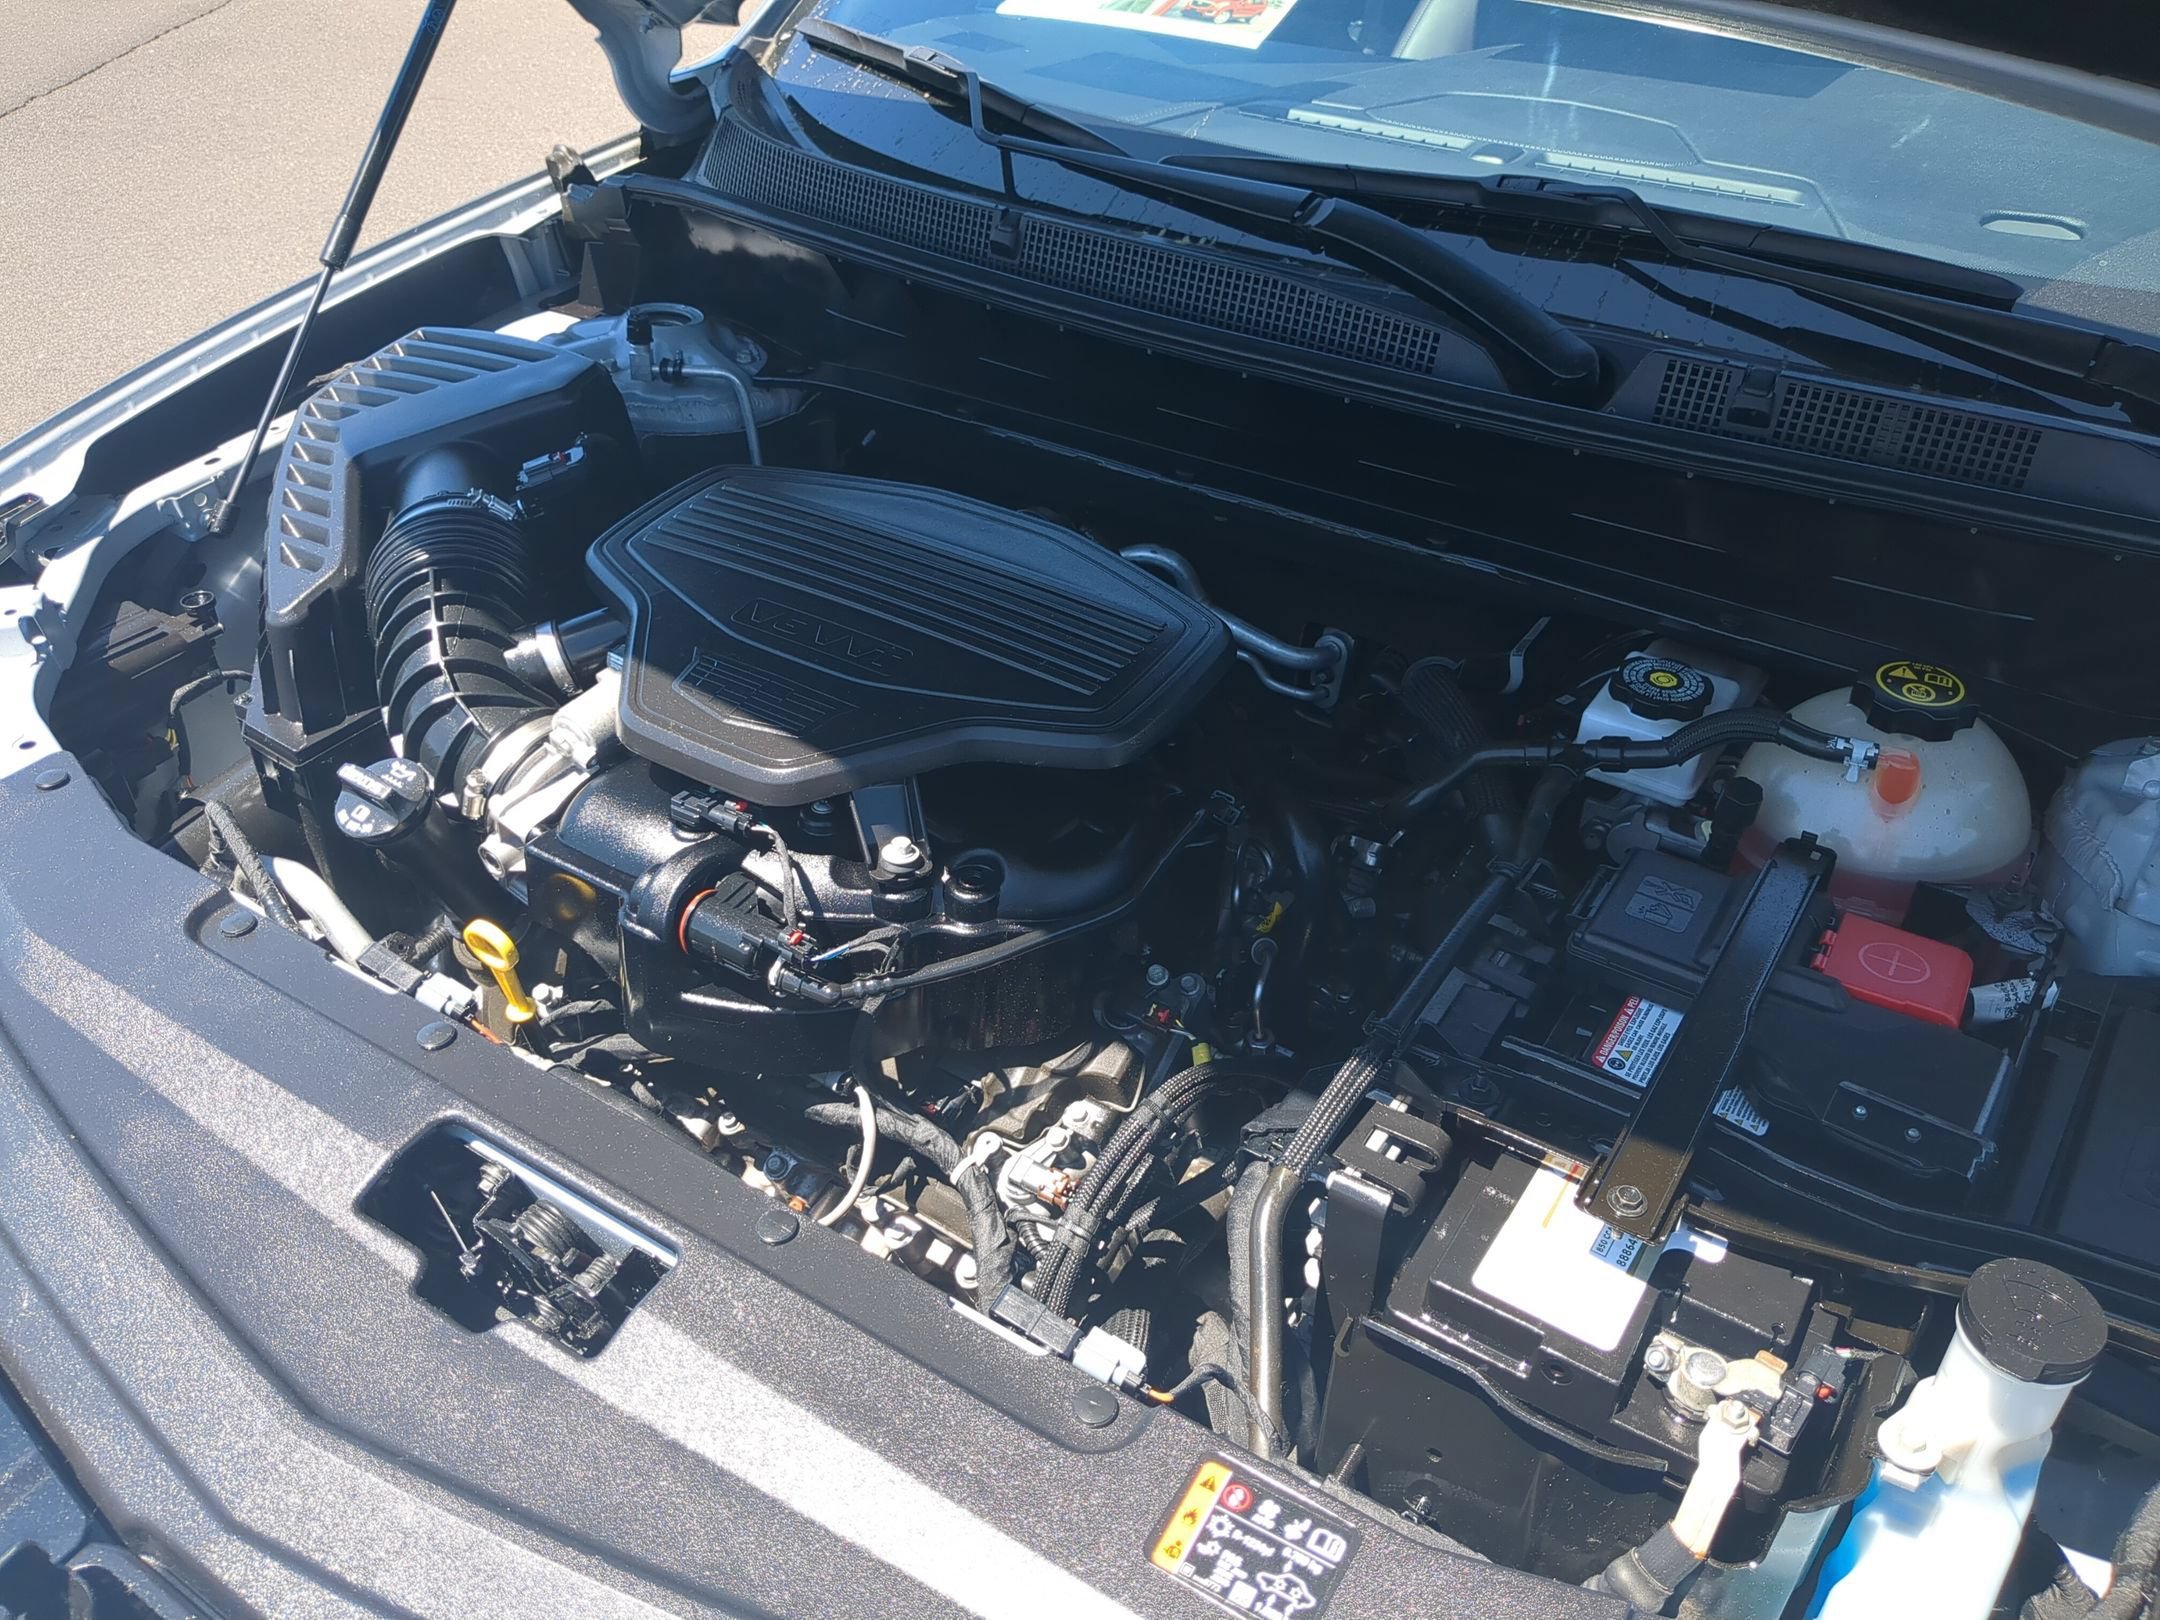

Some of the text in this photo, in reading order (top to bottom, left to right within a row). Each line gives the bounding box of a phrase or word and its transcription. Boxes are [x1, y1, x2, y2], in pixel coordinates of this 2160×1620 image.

[1599, 1013, 1629, 1057] DANGER/POISON
[1631, 1029, 1639, 1038] CAN
[1595, 1240, 1608, 1252] 850
